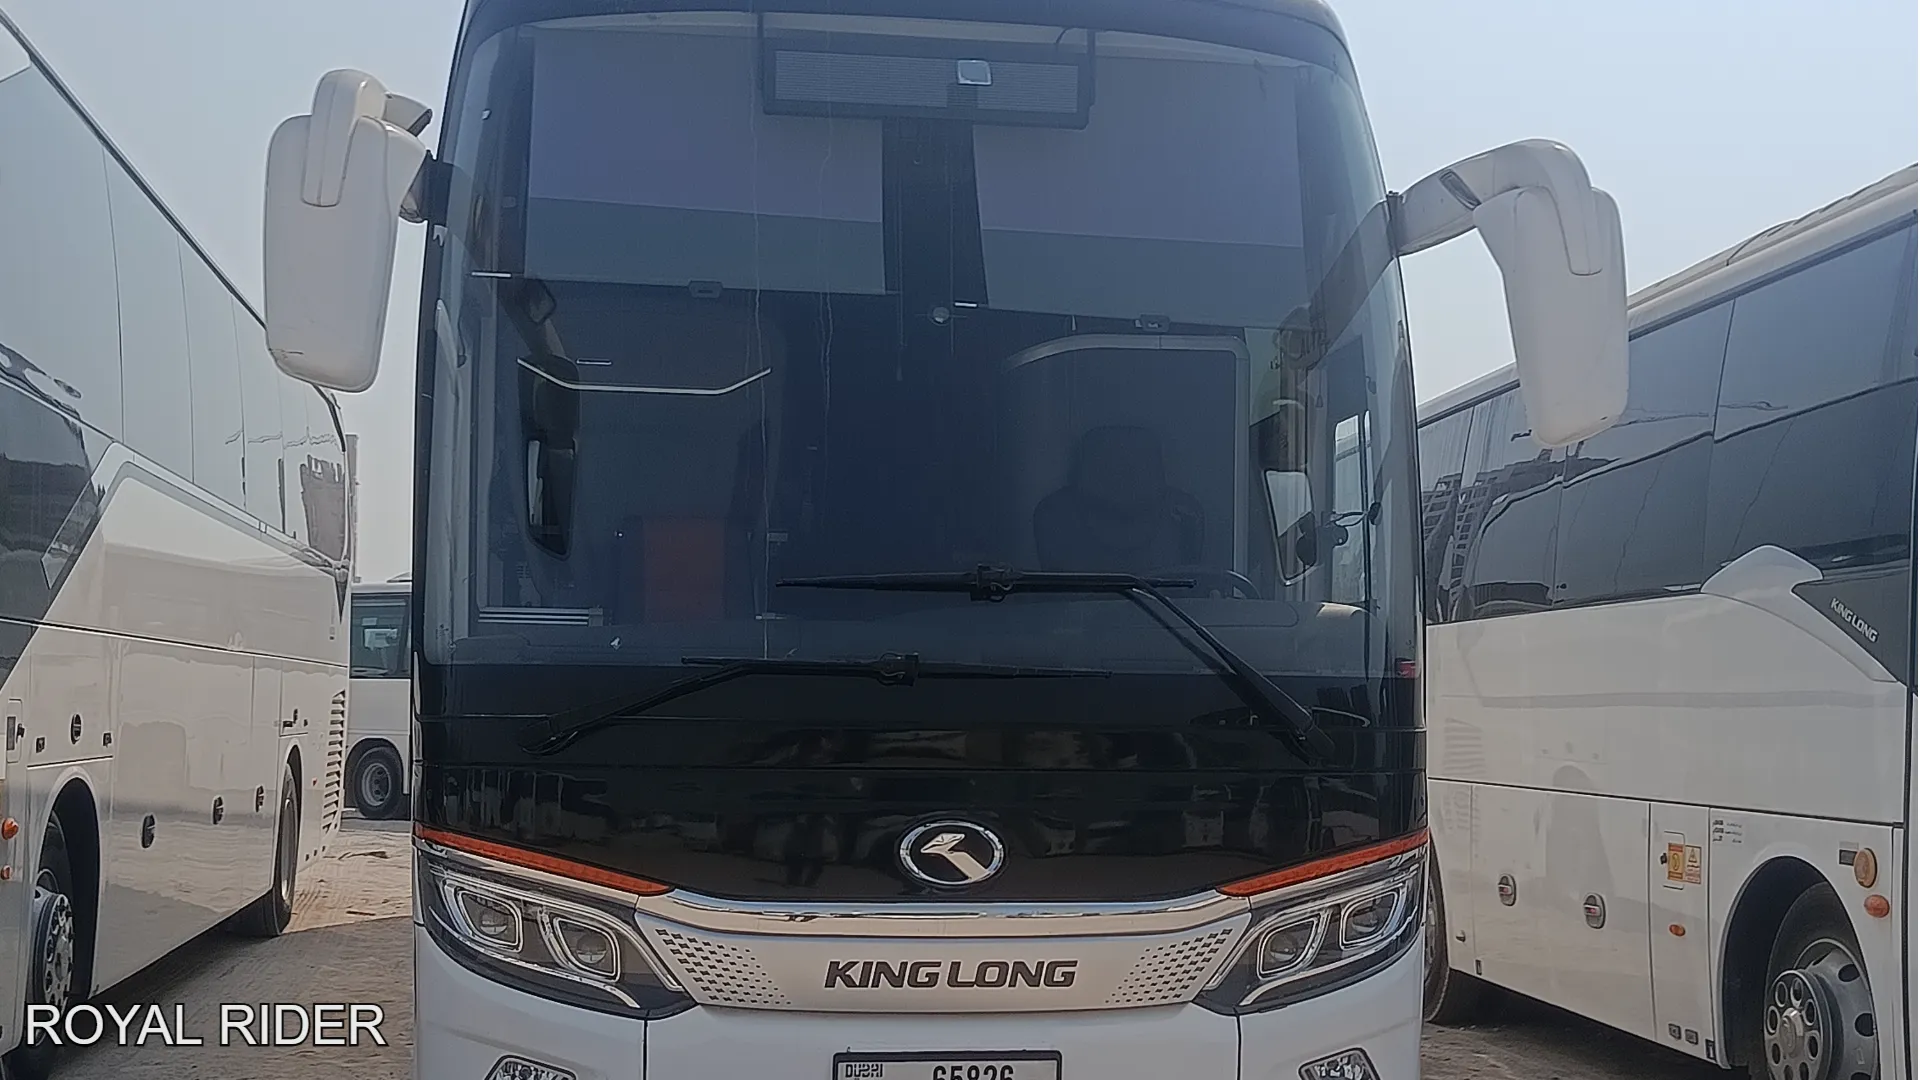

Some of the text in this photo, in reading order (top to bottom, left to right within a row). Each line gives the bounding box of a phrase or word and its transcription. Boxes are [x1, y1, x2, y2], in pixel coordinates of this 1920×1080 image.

[1831, 597, 1878, 642] KING LONG
[824, 960, 1078, 988] KING LONG
